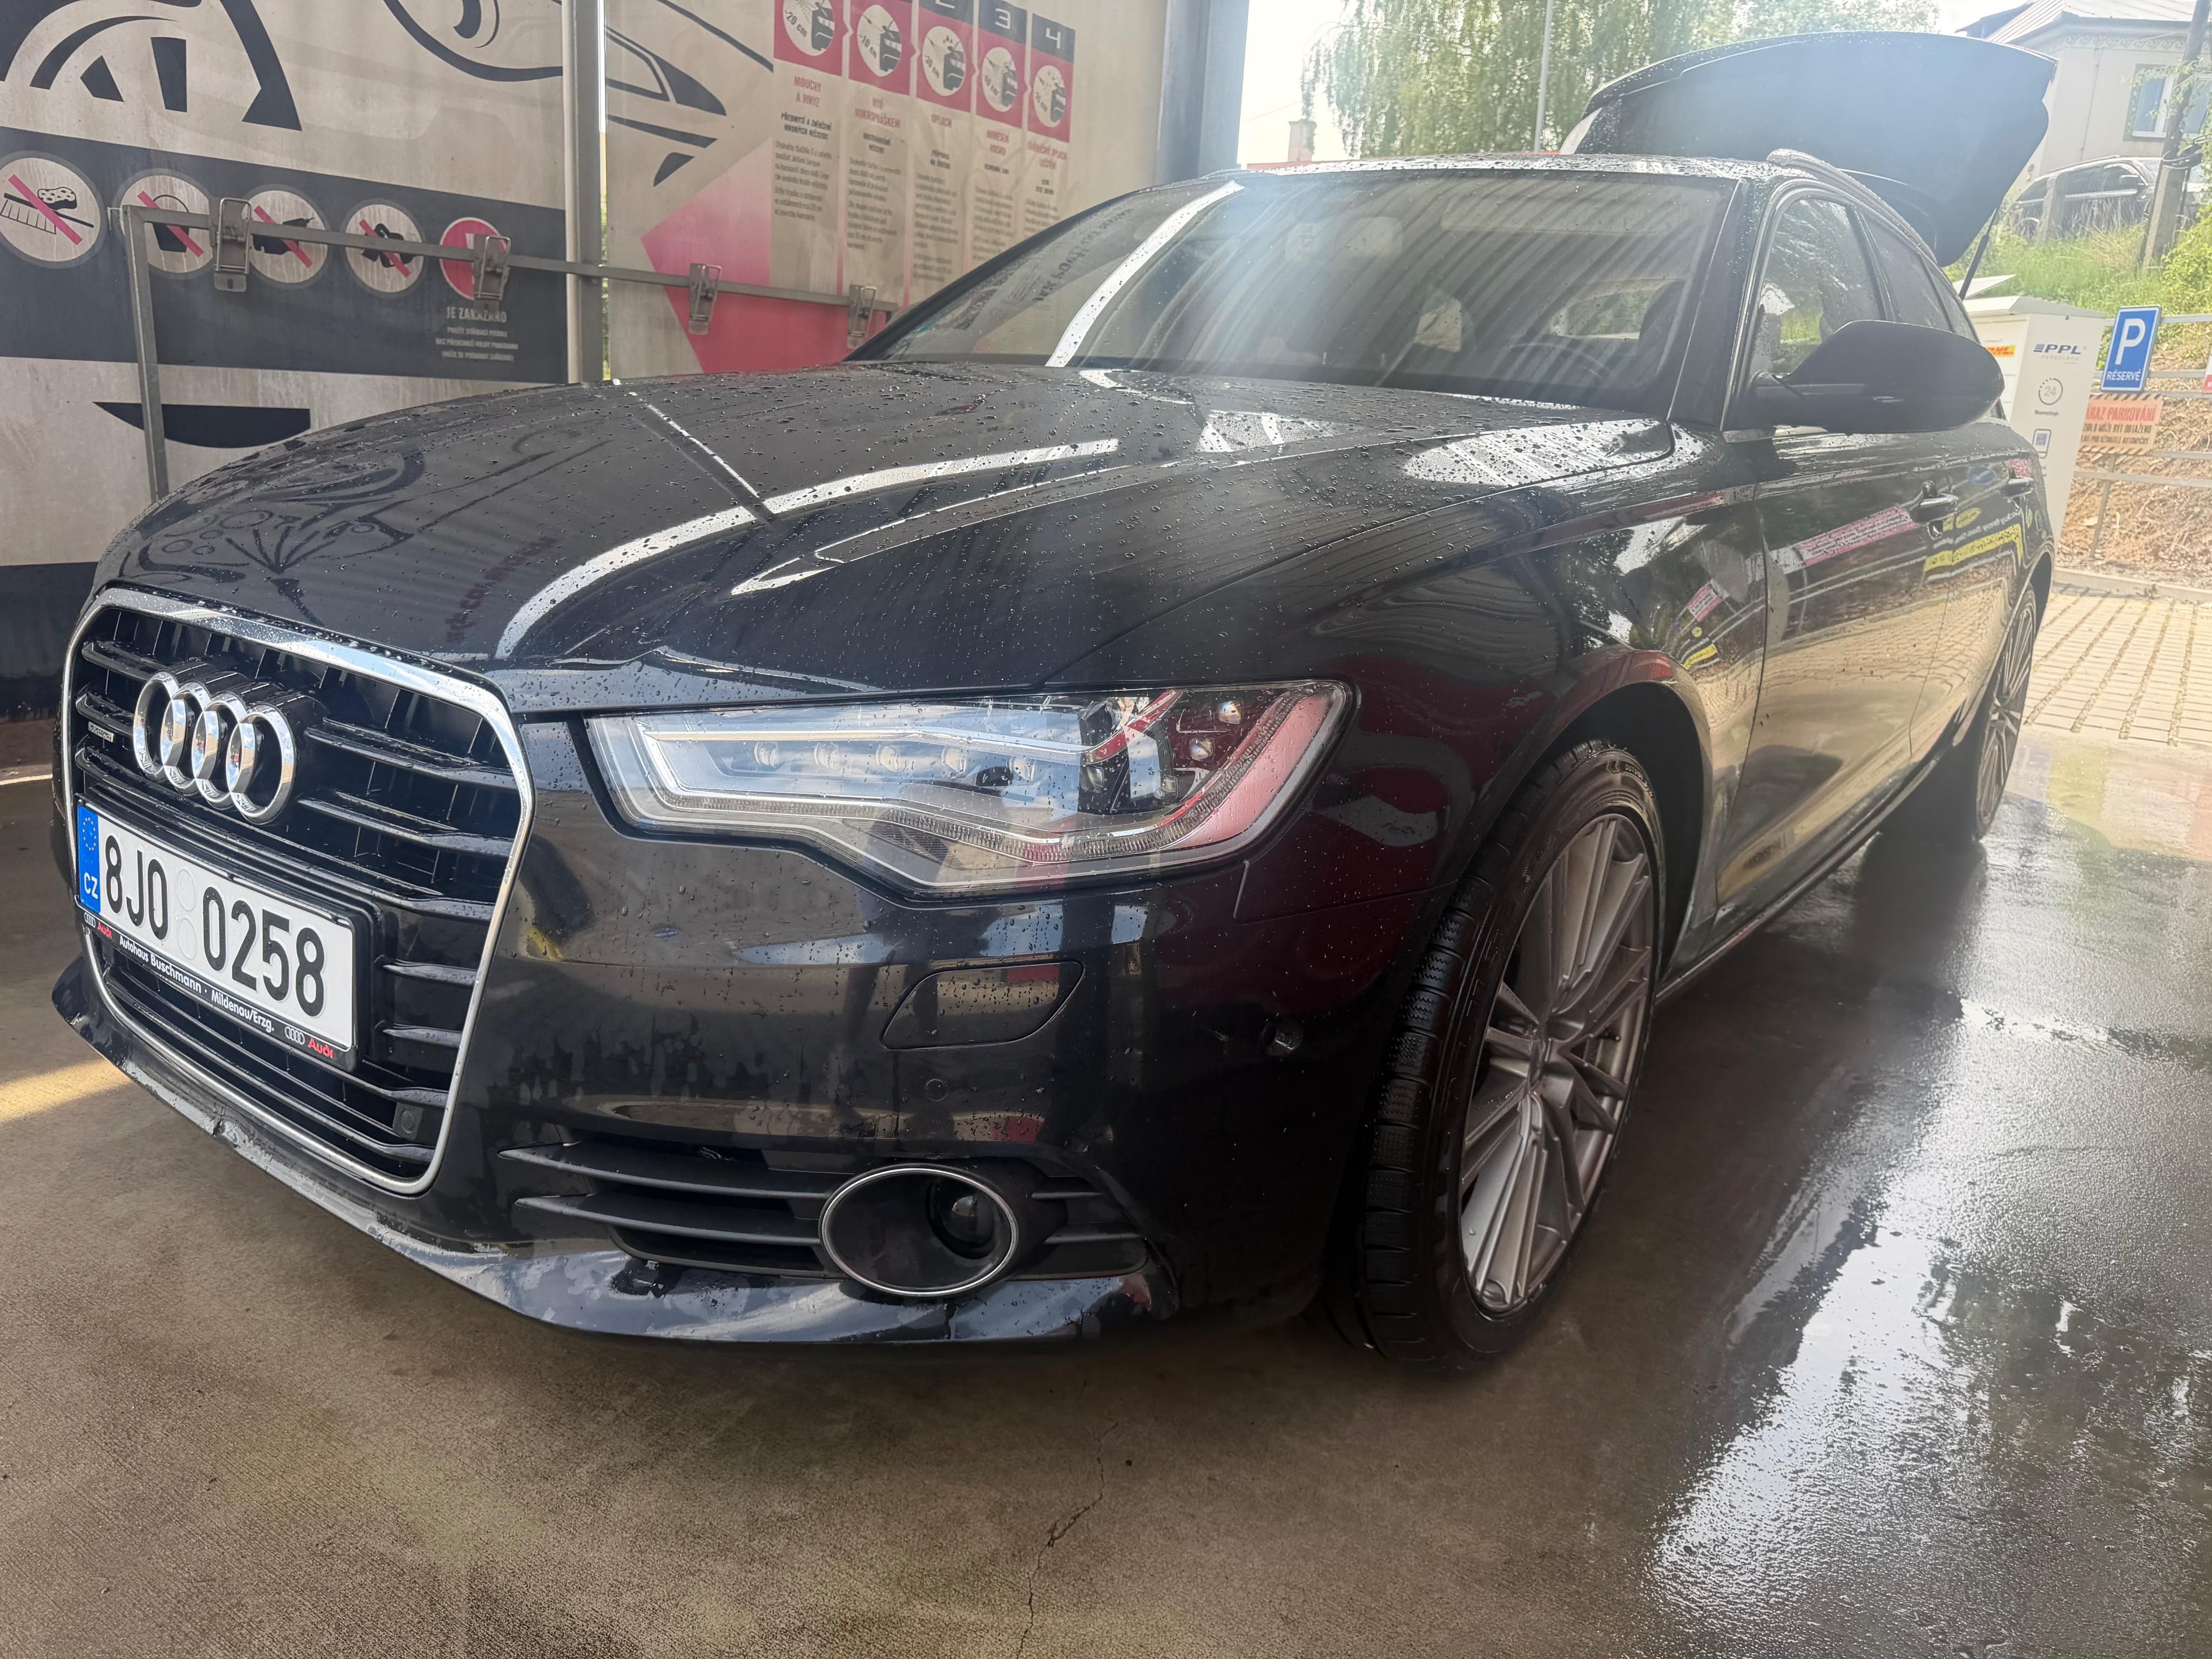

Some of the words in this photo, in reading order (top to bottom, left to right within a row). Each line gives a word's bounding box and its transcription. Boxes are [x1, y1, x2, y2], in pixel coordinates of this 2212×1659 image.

[995, 8, 1011, 30] 3
[1046, 28, 1061, 49] 4
[446, 306, 456, 319] JE
[2044, 344, 2081, 355] PPL
[2115, 318, 2146, 365] P
[2106, 369, 2141, 381] RÉSERVÉ
[2085, 406, 2107, 420] ÁKAZ
[2107, 405, 2156, 421] PARKOVÁNÍ
[84, 872, 98, 900] CZ
[97, 921, 112, 939] Audi
[105, 835, 168, 940] 8J0
[203, 886, 325, 1017] 0258
[119, 935, 149, 962] Autohaus
[151, 953, 201, 994] Buschmann
[211, 989, 274, 1033] Mildenau/Erzg.
[307, 1037, 334, 1059] Audi
